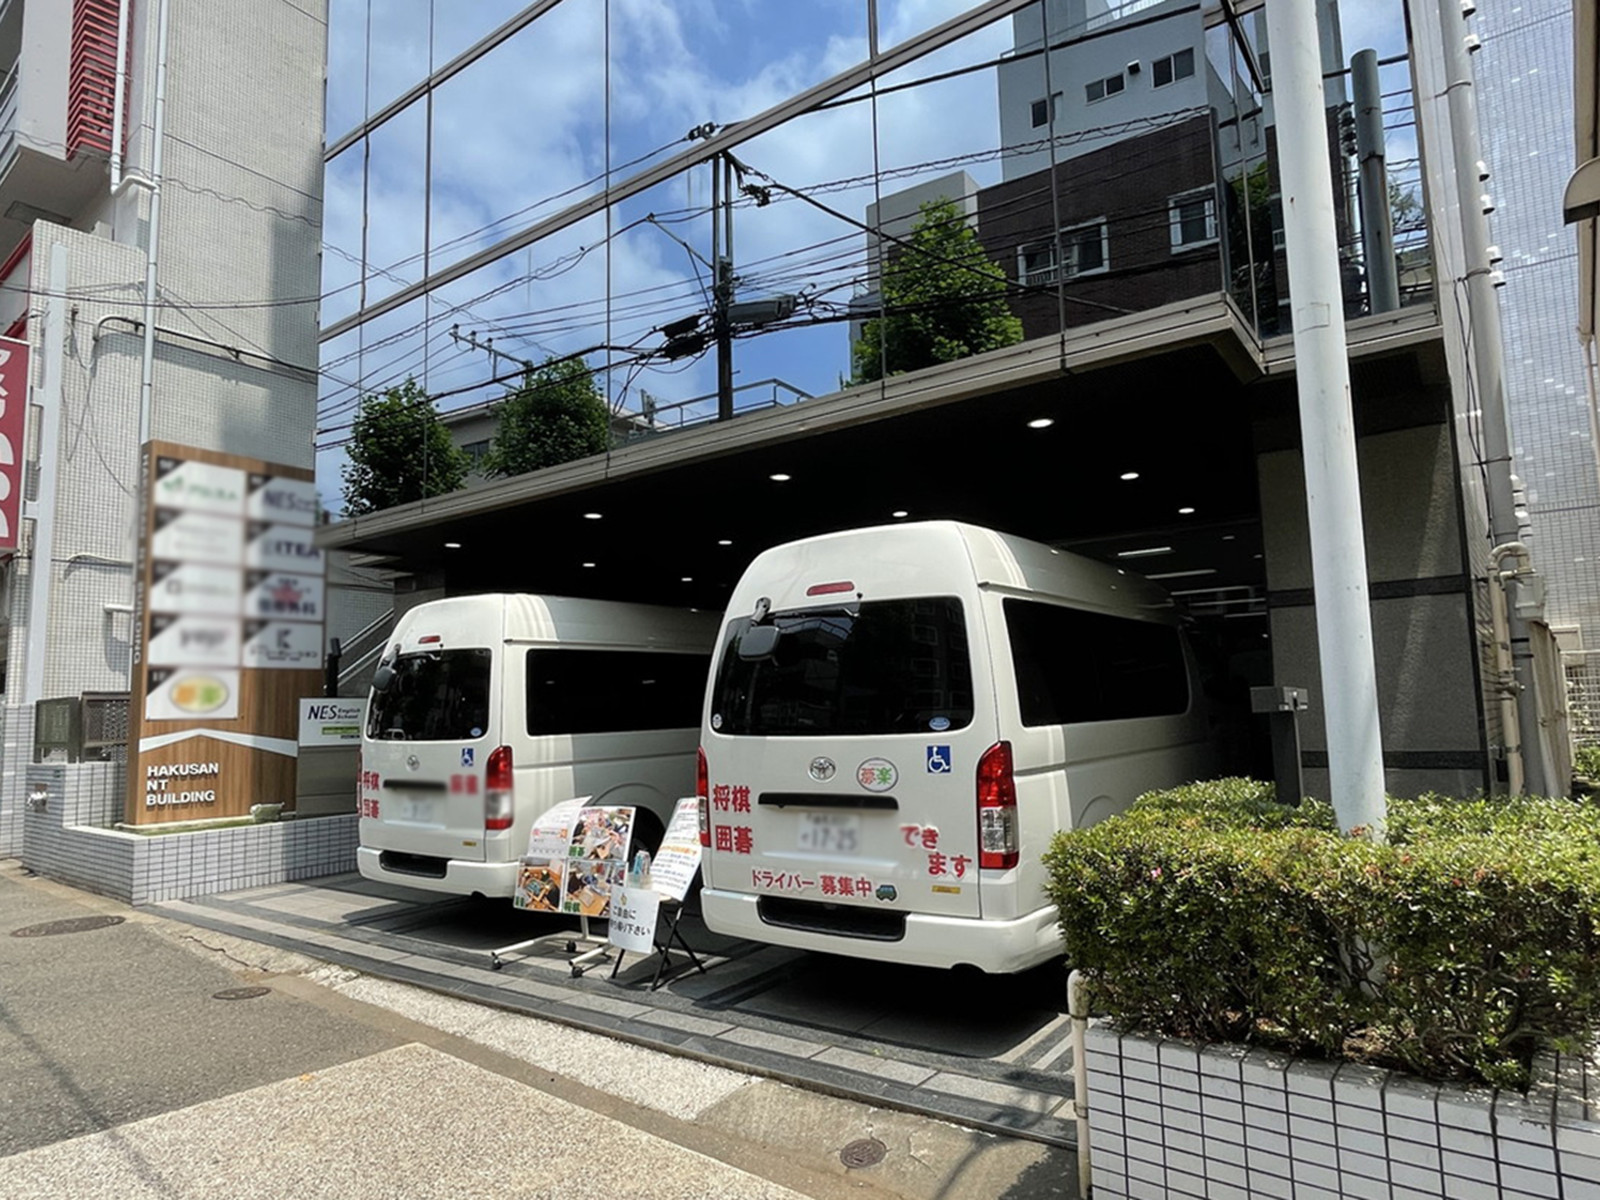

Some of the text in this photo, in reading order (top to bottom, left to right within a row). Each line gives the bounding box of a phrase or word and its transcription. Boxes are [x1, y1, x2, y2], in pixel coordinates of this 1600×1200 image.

[307, 704, 337, 720] NES
[147, 763, 219, 777] HAKUSAN
[146, 779, 168, 791] NT
[146, 790, 215, 806] BUILDING
[713, 783, 751, 813] 将棋
[715, 825, 753, 854] 囲碁
[900, 825, 939, 850] でき
[928, 851, 972, 878] ます
[752, 869, 873, 897] ドライバー 募集中
